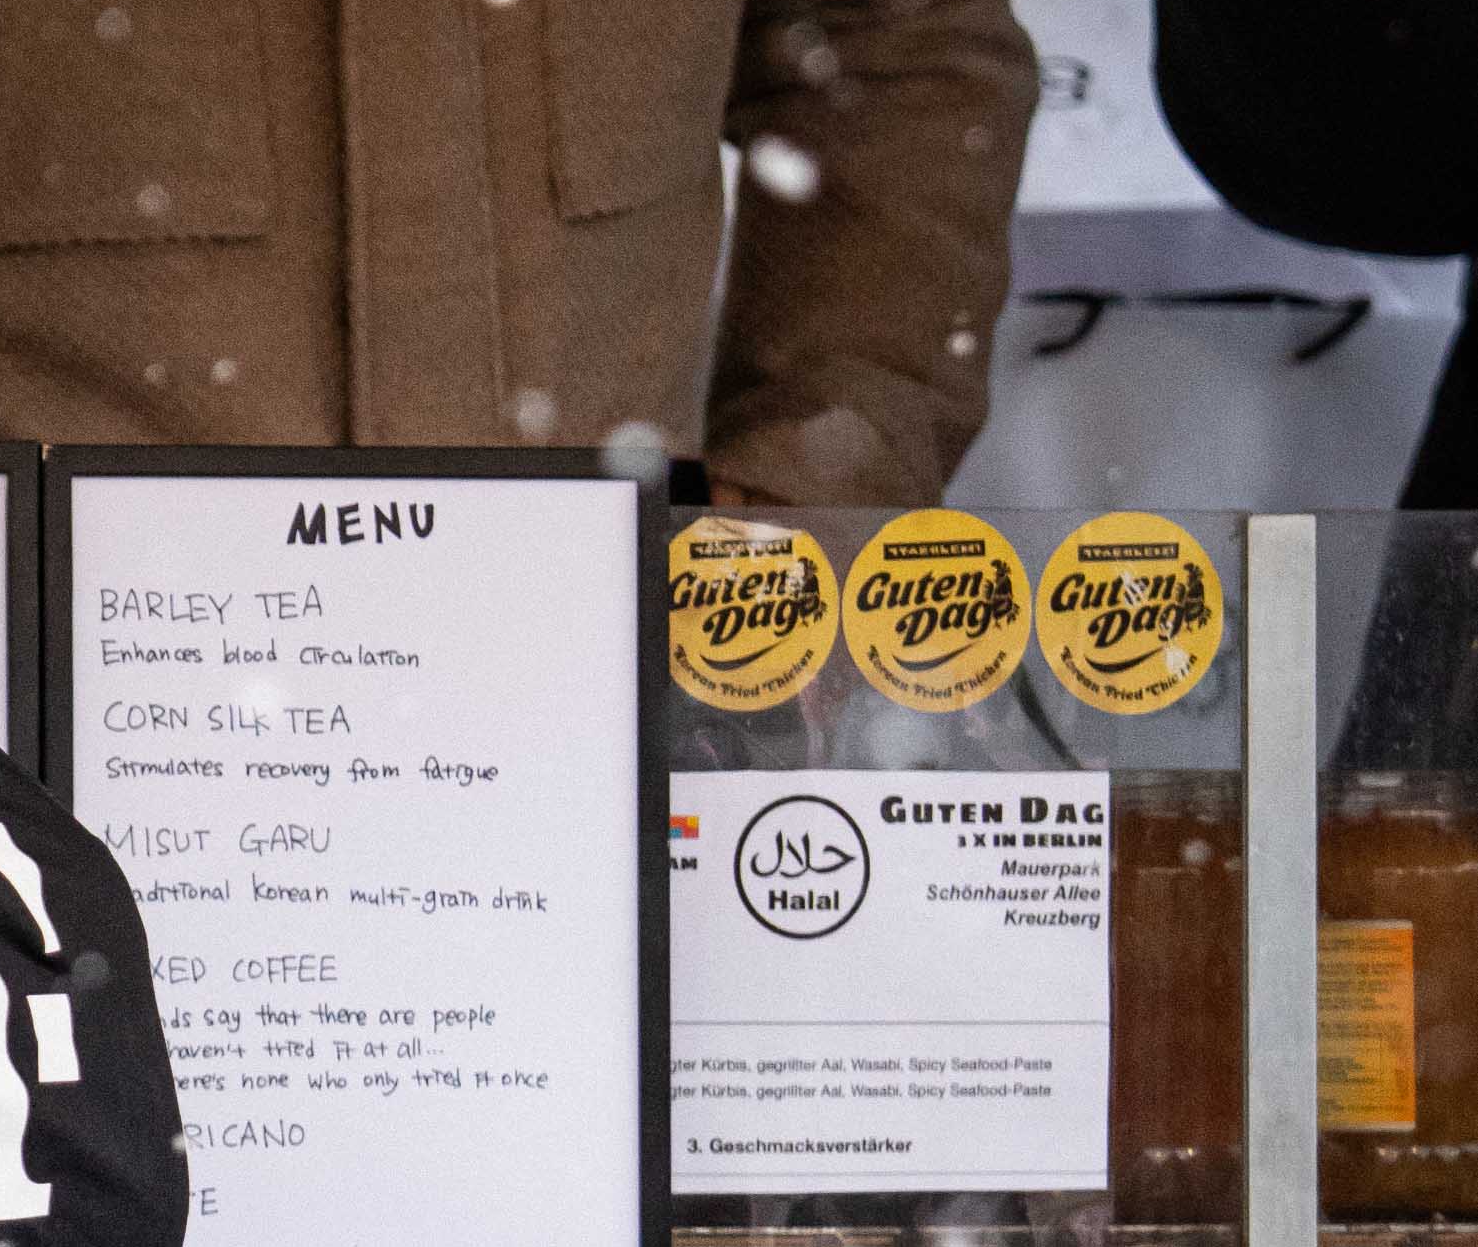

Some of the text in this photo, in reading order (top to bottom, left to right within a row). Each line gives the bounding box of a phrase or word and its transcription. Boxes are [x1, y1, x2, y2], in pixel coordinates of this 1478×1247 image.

[287, 501, 435, 545] MENU
[100, 584, 323, 625] BARLEY TEA
[856, 571, 984, 612] Guten
[702, 599, 798, 647] Dag
[895, 600, 993, 647] Dag
[1088, 603, 1185, 648] Dag
[100, 639, 420, 668] Enhances blood circulation
[103, 701, 188, 733] CORN
[283, 704, 351, 735] TEA
[105, 755, 499, 787] Stimulates recovery from fatigue
[105, 823, 331, 857] MISUT GARU
[750, 829, 856, 878] حلال
[993, 833, 1017, 847] IN
[1022, 833, 1102, 847] BERLIN
[1000, 859, 1100, 880] Mauerpark
[132, 879, 230, 903] aditional
[349, 885, 479, 914] multi-grain
[492, 886, 548, 913] drink
[769, 889, 840, 911] Halal
[926, 884, 1101, 902] Schönhauser Allee
[1003, 909, 1101, 930] Kreuzberg
[233, 955, 338, 984] COFFEE
[204, 1008, 242, 1033] say
[255, 1005, 301, 1028] that
[310, 1002, 367, 1027] there
[379, 1009, 415, 1026] are
[433, 1004, 497, 1033] people
[263, 1039, 316, 1060] tried
[364, 1041, 389, 1059] at
[851, 1056, 904, 1072] Wasabi,
[908, 1056, 946, 1074] Spicy
[241, 1072, 290, 1090] none
[307, 1069, 348, 1091] who
[363, 1069, 400, 1096] only
[411, 1066, 463, 1089] tried
[501, 1070, 550, 1091] once
[851, 1082, 903, 1098] Wasabi,
[907, 1082, 945, 1100] Spicy
[686, 1136, 913, 1154] 3. Geschmacksverstärker
